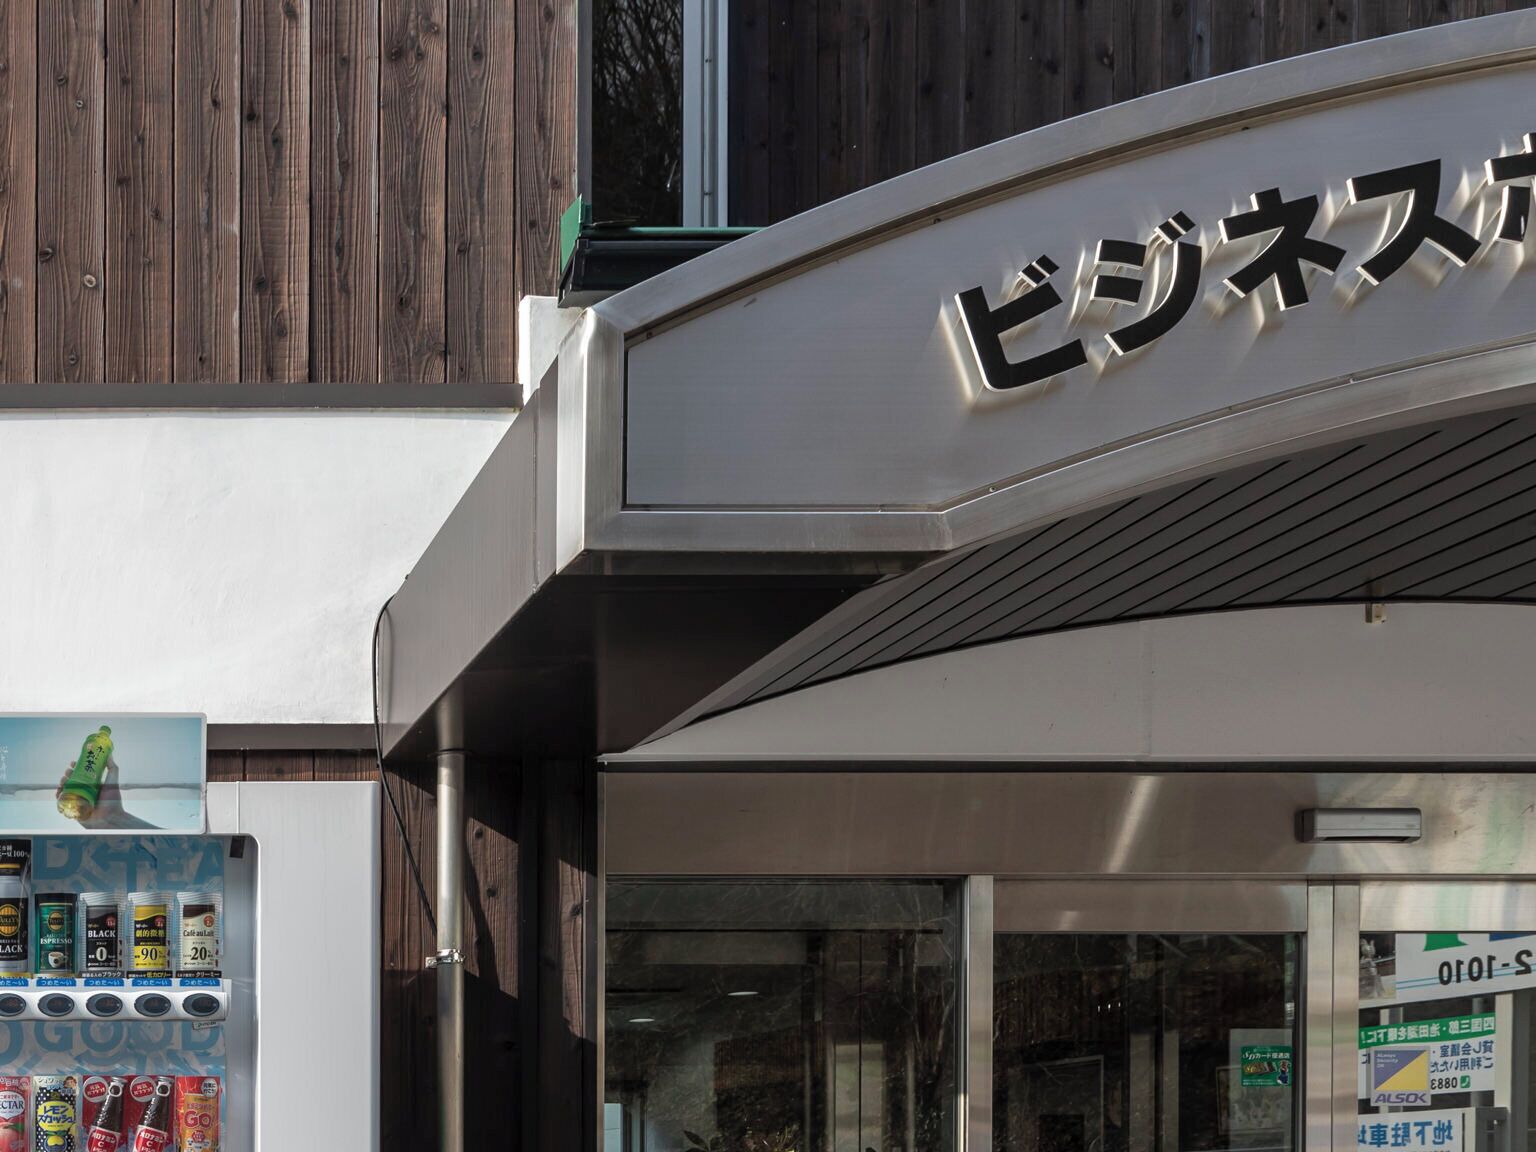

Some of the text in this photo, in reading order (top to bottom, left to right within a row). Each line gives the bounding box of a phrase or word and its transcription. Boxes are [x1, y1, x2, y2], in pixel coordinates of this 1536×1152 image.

[87, 929, 116, 938] BLACK
[40, 937, 73, 945] ESPRESSO
[1374, 1093, 1427, 1104] ALSOK
[43, 1105, 69, 1115] レモン
[37, 1114, 74, 1123] スカッシュ
[185, 1109, 212, 1128] GO
[92, 1131, 115, 1144] オロナミン
[139, 1131, 164, 1144] オロナミン
